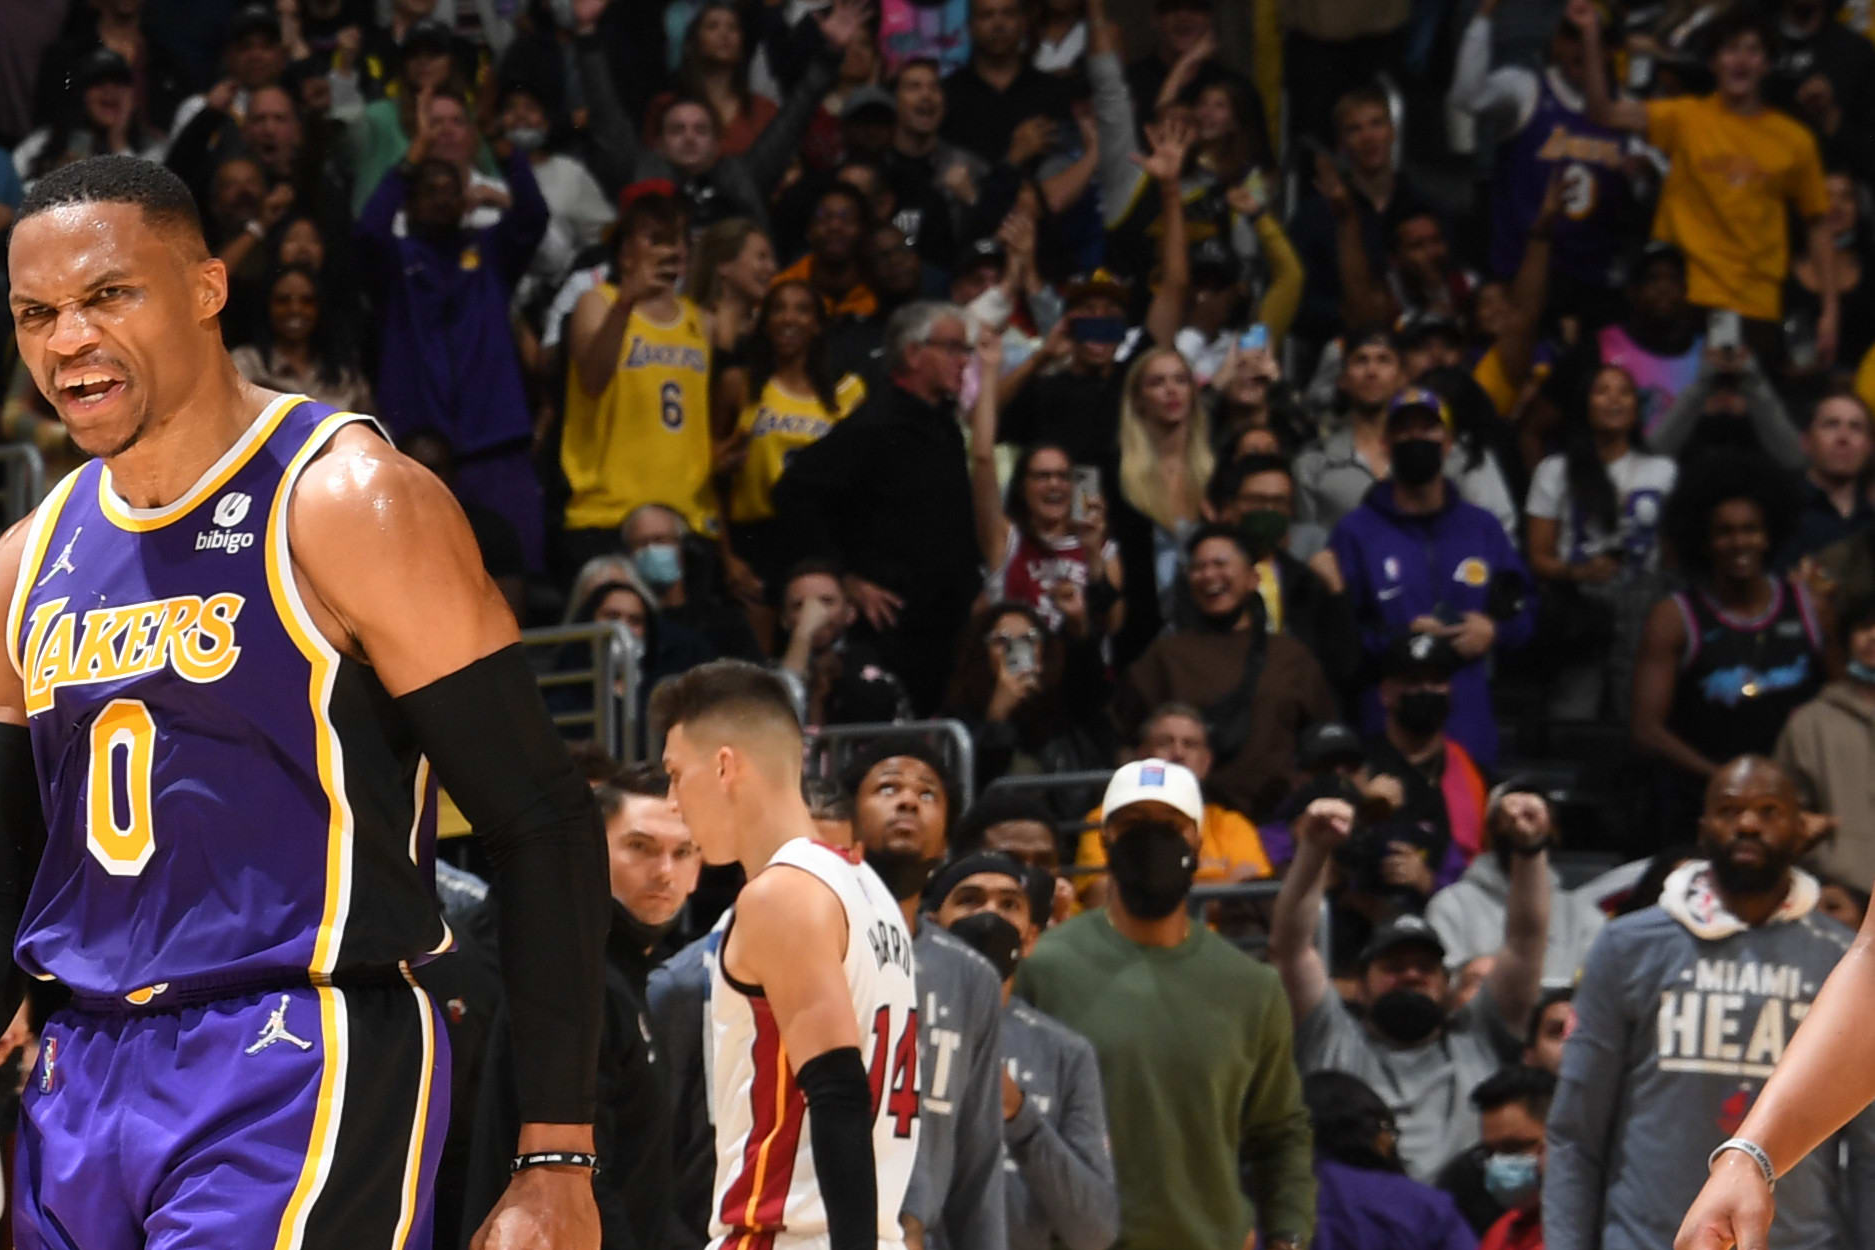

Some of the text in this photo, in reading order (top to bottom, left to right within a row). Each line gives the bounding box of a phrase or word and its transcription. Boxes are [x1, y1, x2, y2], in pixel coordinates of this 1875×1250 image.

[660, 380, 684, 432] 6
[195, 529, 254, 555] bibigo
[23, 592, 246, 718] LAKERS
[87, 698, 156, 876] 0
[1694, 957, 1803, 1001] MIAMI
[867, 1004, 920, 1139] 14
